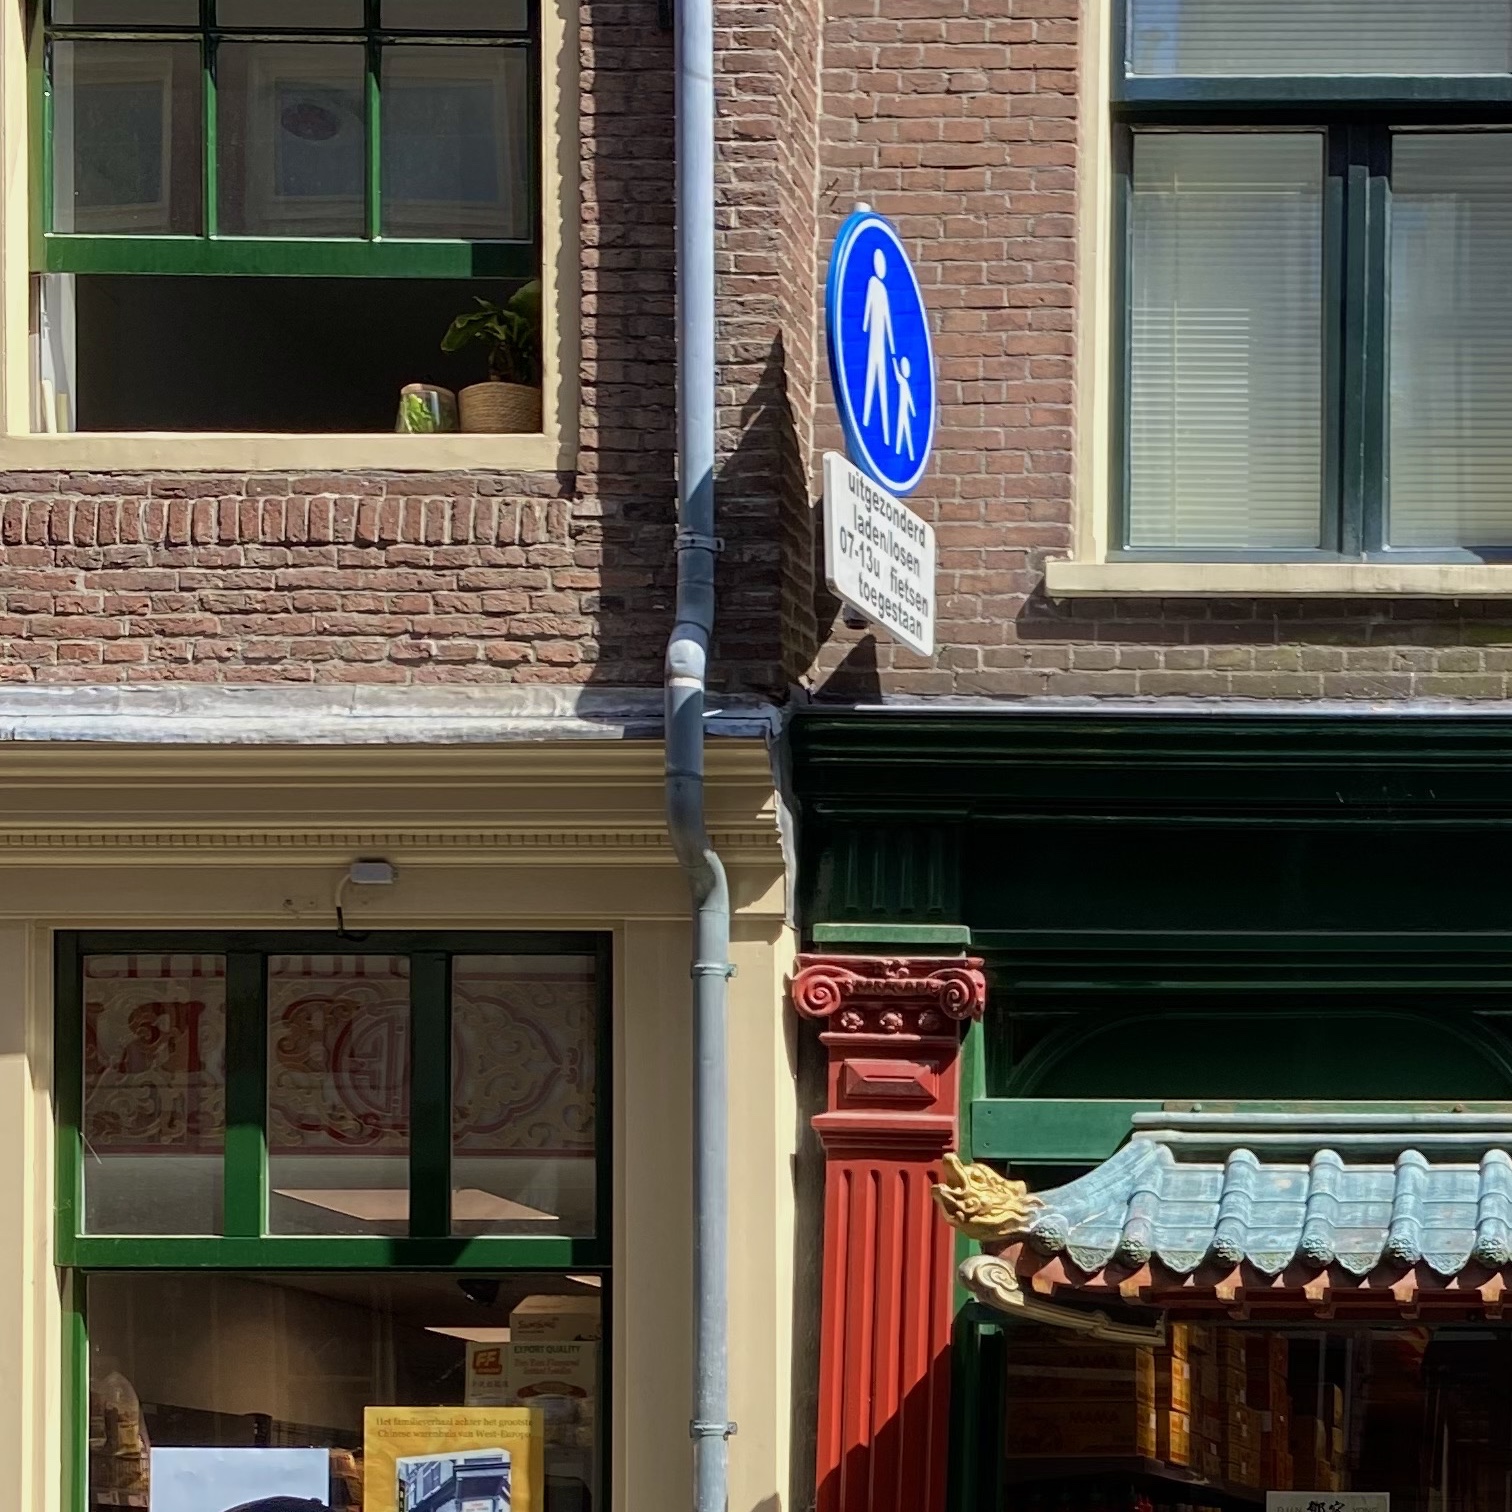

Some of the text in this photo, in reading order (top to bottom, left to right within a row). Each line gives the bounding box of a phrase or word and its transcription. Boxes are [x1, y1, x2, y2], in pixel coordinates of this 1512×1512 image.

[848, 472, 926, 548] uitgezonderd
[853, 504, 920, 578] laden/losen
[840, 526, 929, 617] 07-13u fietsen
[858, 572, 923, 641] toegestaan
